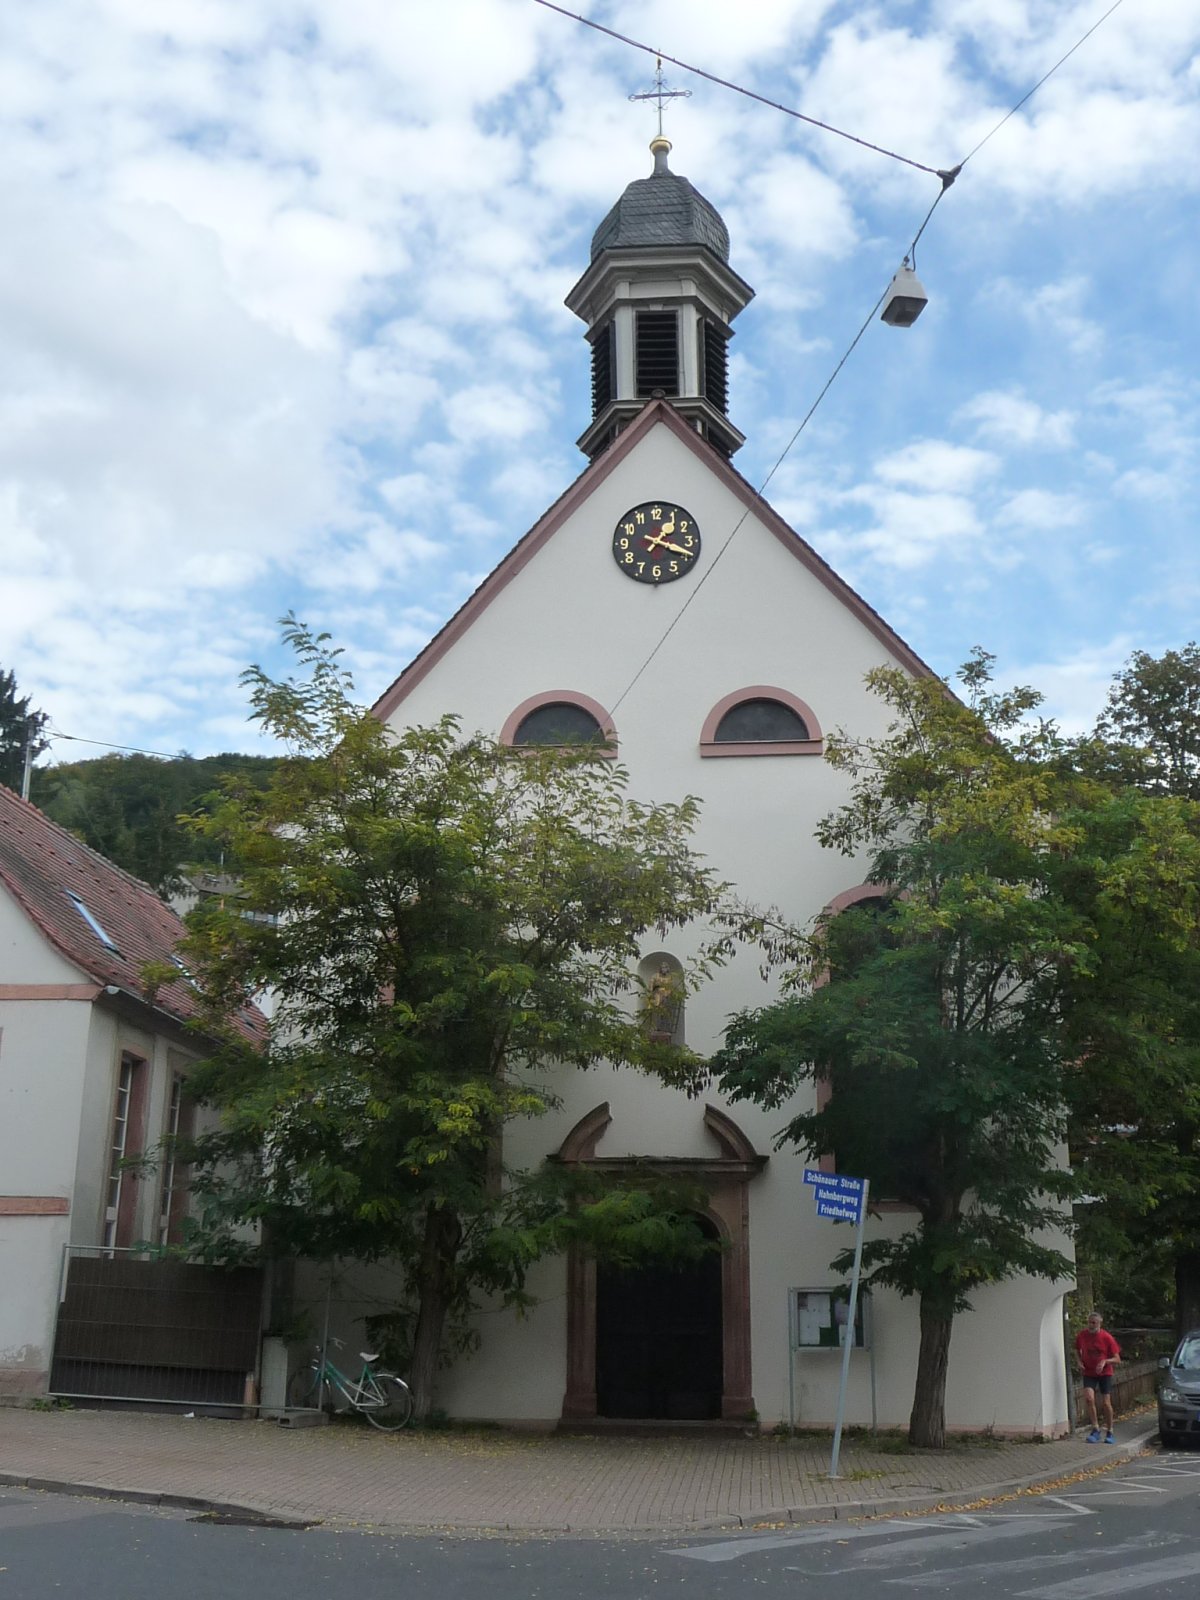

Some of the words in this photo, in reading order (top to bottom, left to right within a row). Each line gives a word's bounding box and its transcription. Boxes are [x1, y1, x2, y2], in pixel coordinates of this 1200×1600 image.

[636, 513, 644, 524] 11
[651, 508, 662, 520] 12
[625, 523, 634, 535] 10
[681, 521, 688, 532] 2
[620, 538, 628, 550] 9
[685, 536, 693, 547] 3
[625, 552, 633, 563] 8
[637, 562, 645, 574] 7
[652, 566, 661, 577] 6
[669, 561, 678, 572] 5
[807, 1172, 838, 1187] Schönauer
[841, 1178, 860, 1190] Straße
[821, 1204, 857, 1221] Friedhofweg
